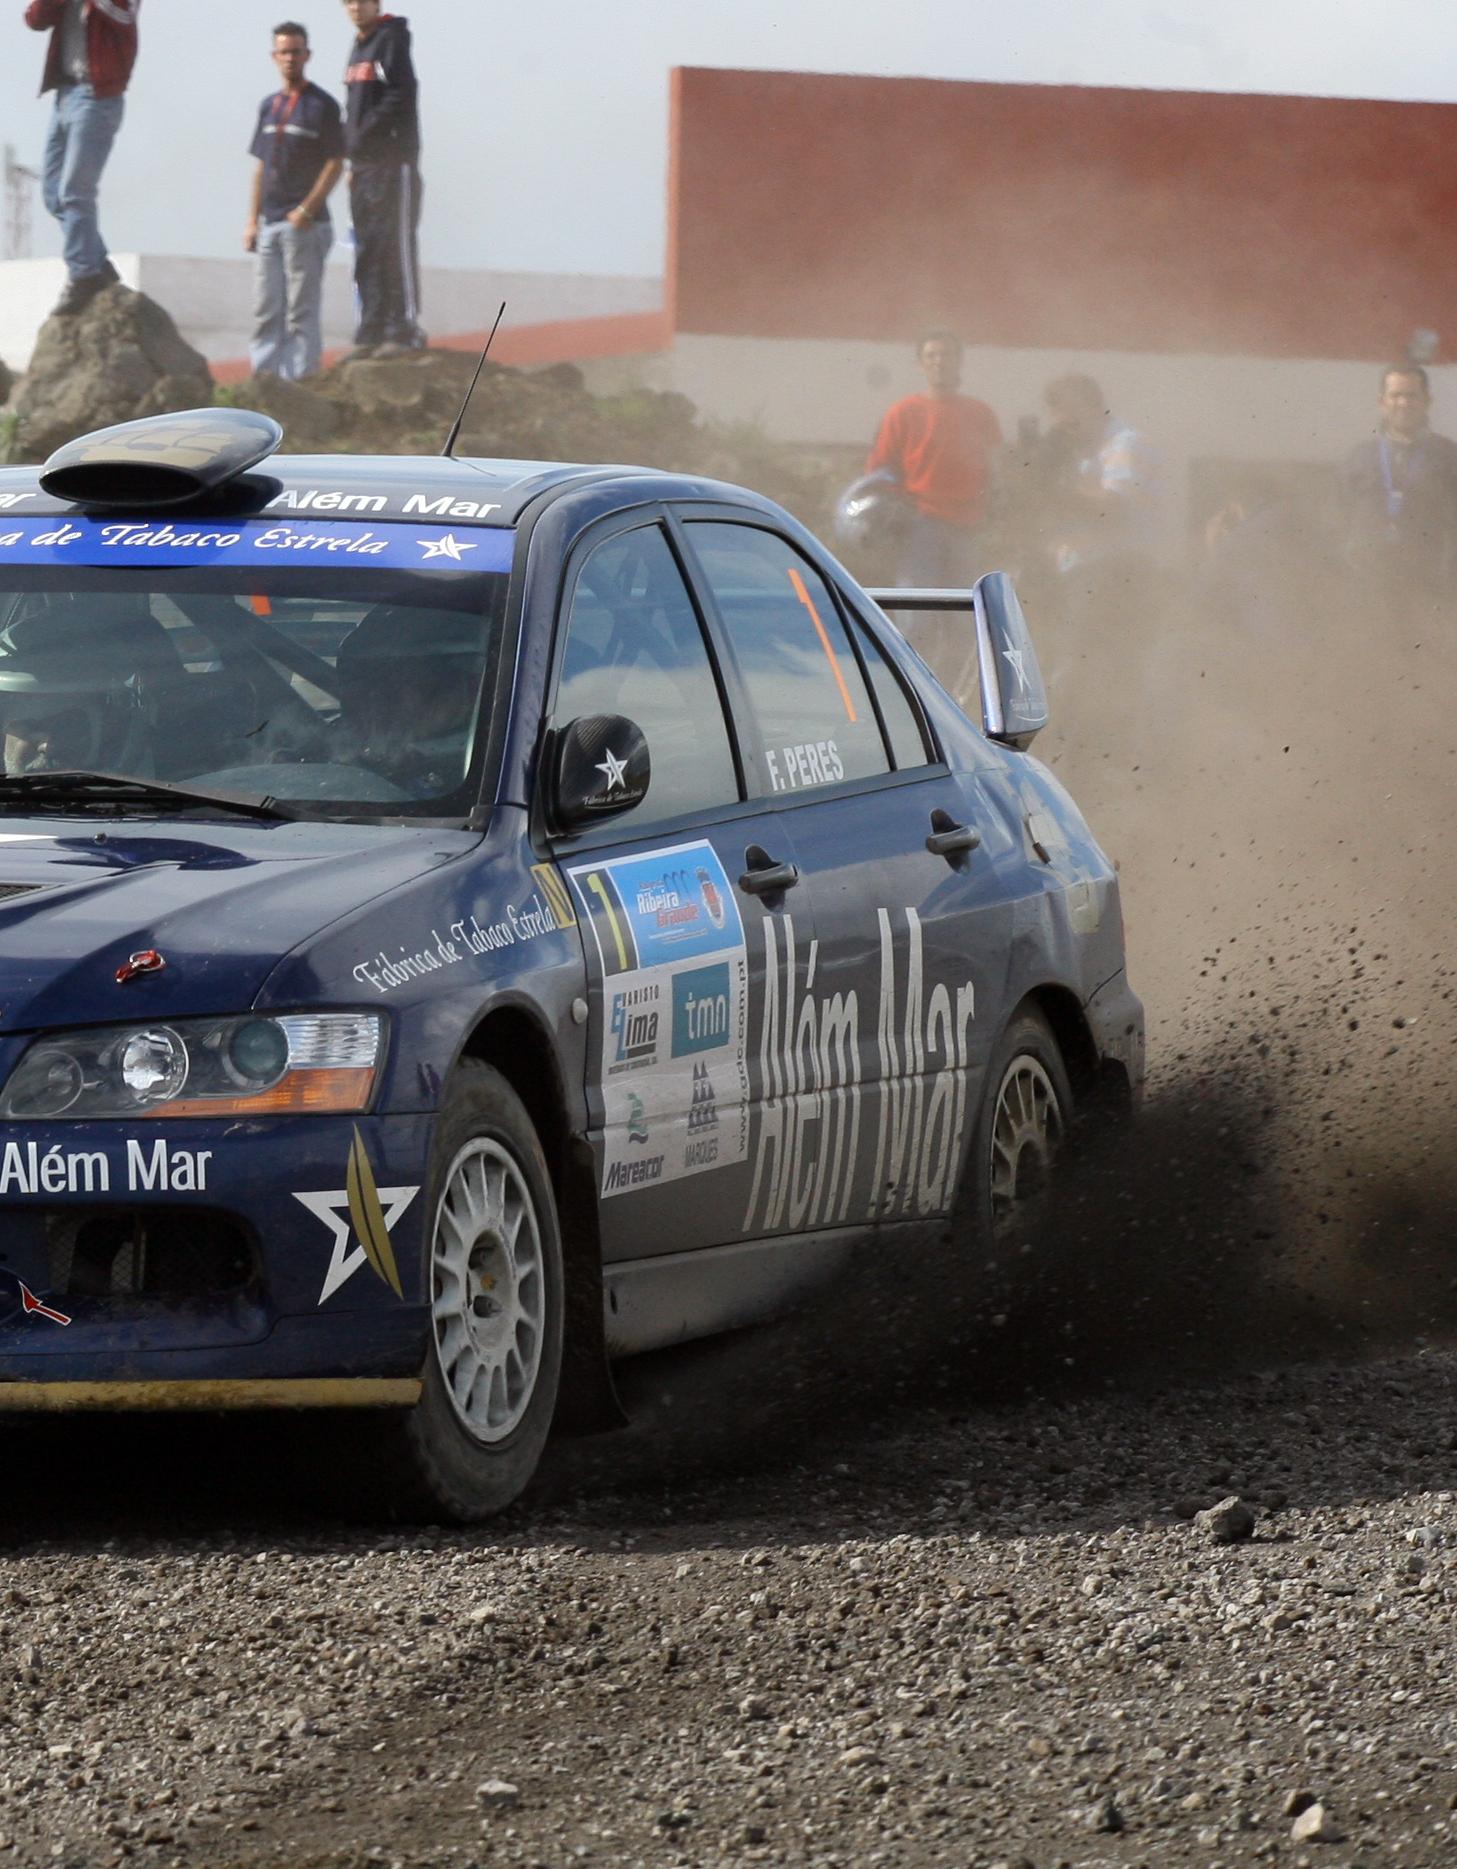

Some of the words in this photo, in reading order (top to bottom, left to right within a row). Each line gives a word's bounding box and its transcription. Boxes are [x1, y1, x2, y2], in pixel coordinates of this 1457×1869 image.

[266, 489, 388, 512] Além
[402, 494, 502, 518] Mar
[30, 524, 82, 546] de
[101, 524, 241, 548] Tabaco
[254, 528, 391, 554] Estrela
[765, 749, 786, 791] F.
[784, 740, 844, 787] PERES
[587, 873, 628, 970] 1
[637, 887, 679, 914] Ribeira
[353, 946, 442, 993] Fábrica
[432, 930, 463, 963] de
[451, 916, 514, 955] Tabaco
[507, 894, 556, 941] Estrela
[685, 992, 726, 1040] tmn
[126, 1139, 213, 1191] Mar
[604, 1155, 665, 1191] Mareacor
